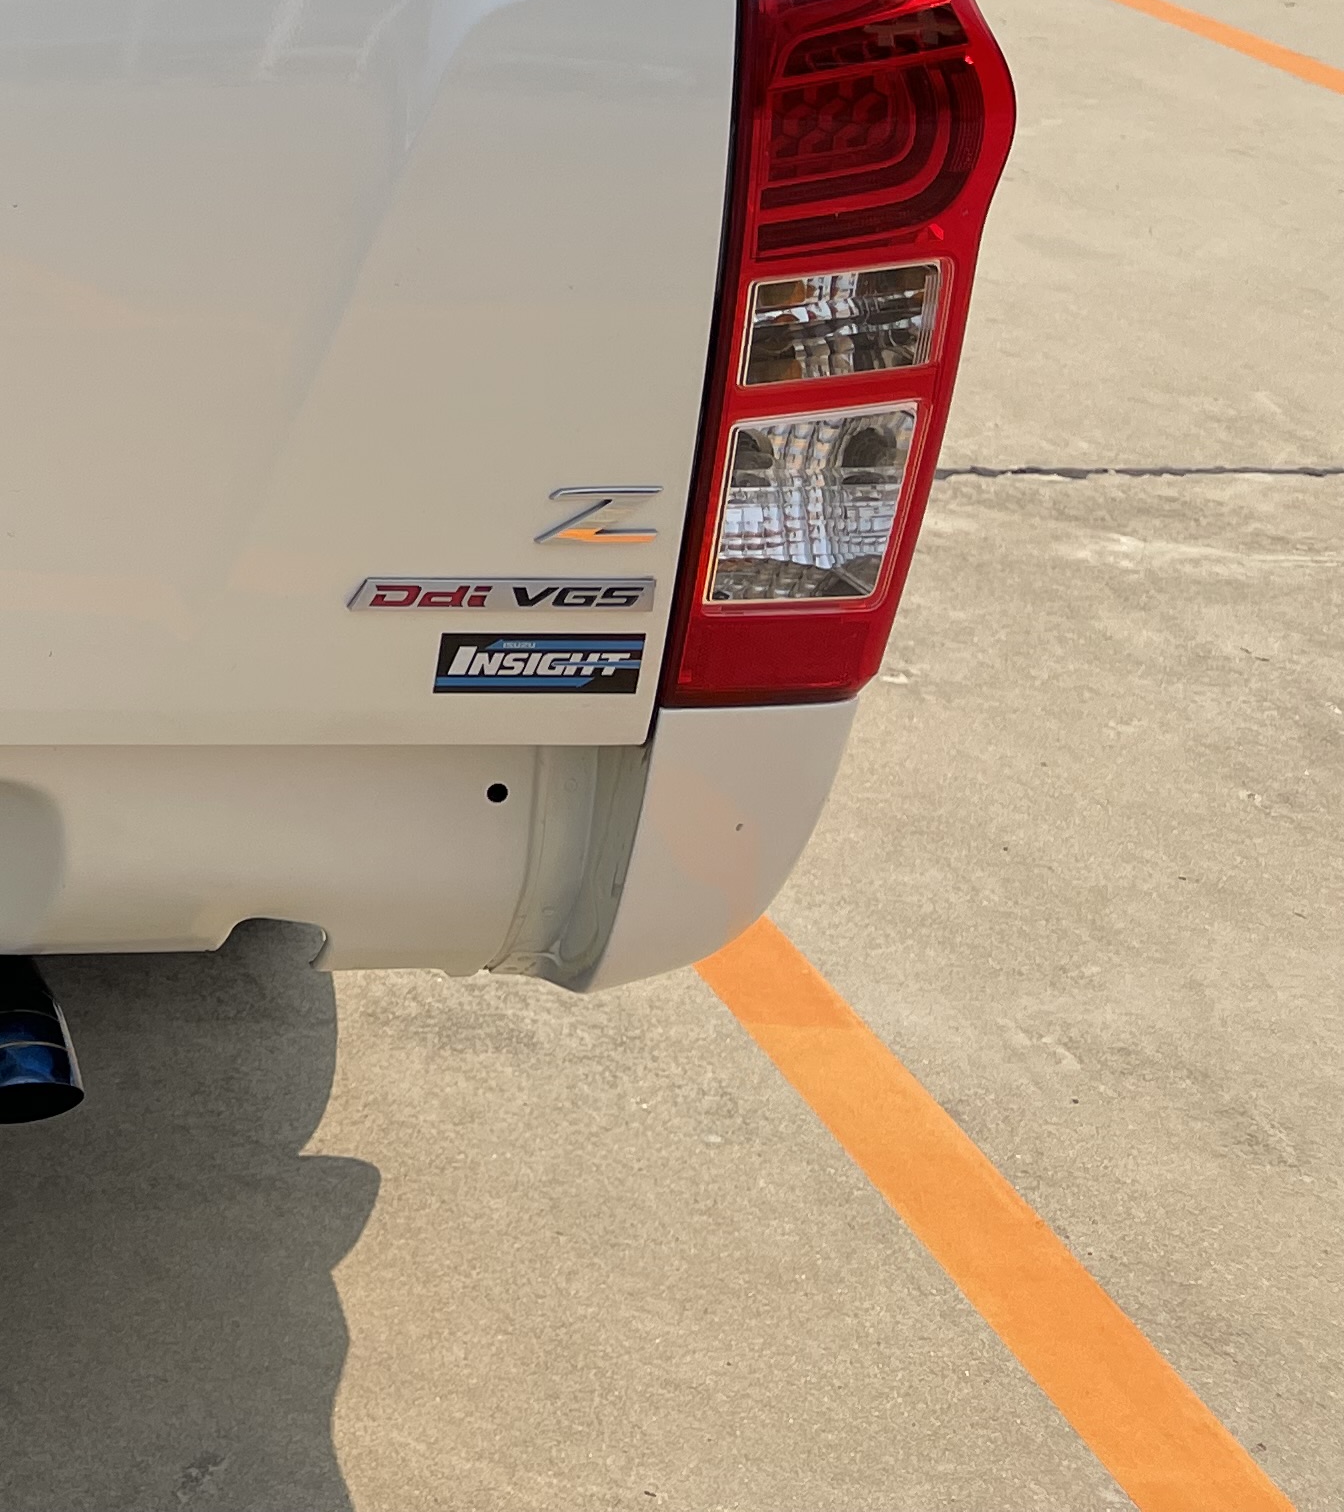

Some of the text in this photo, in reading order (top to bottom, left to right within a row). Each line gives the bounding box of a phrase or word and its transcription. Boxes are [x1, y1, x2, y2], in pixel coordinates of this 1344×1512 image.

[369, 585, 645, 608] Ddi VGS
[502, 641, 536, 649] ISUZU
[448, 646, 631, 676] INSIGHT
